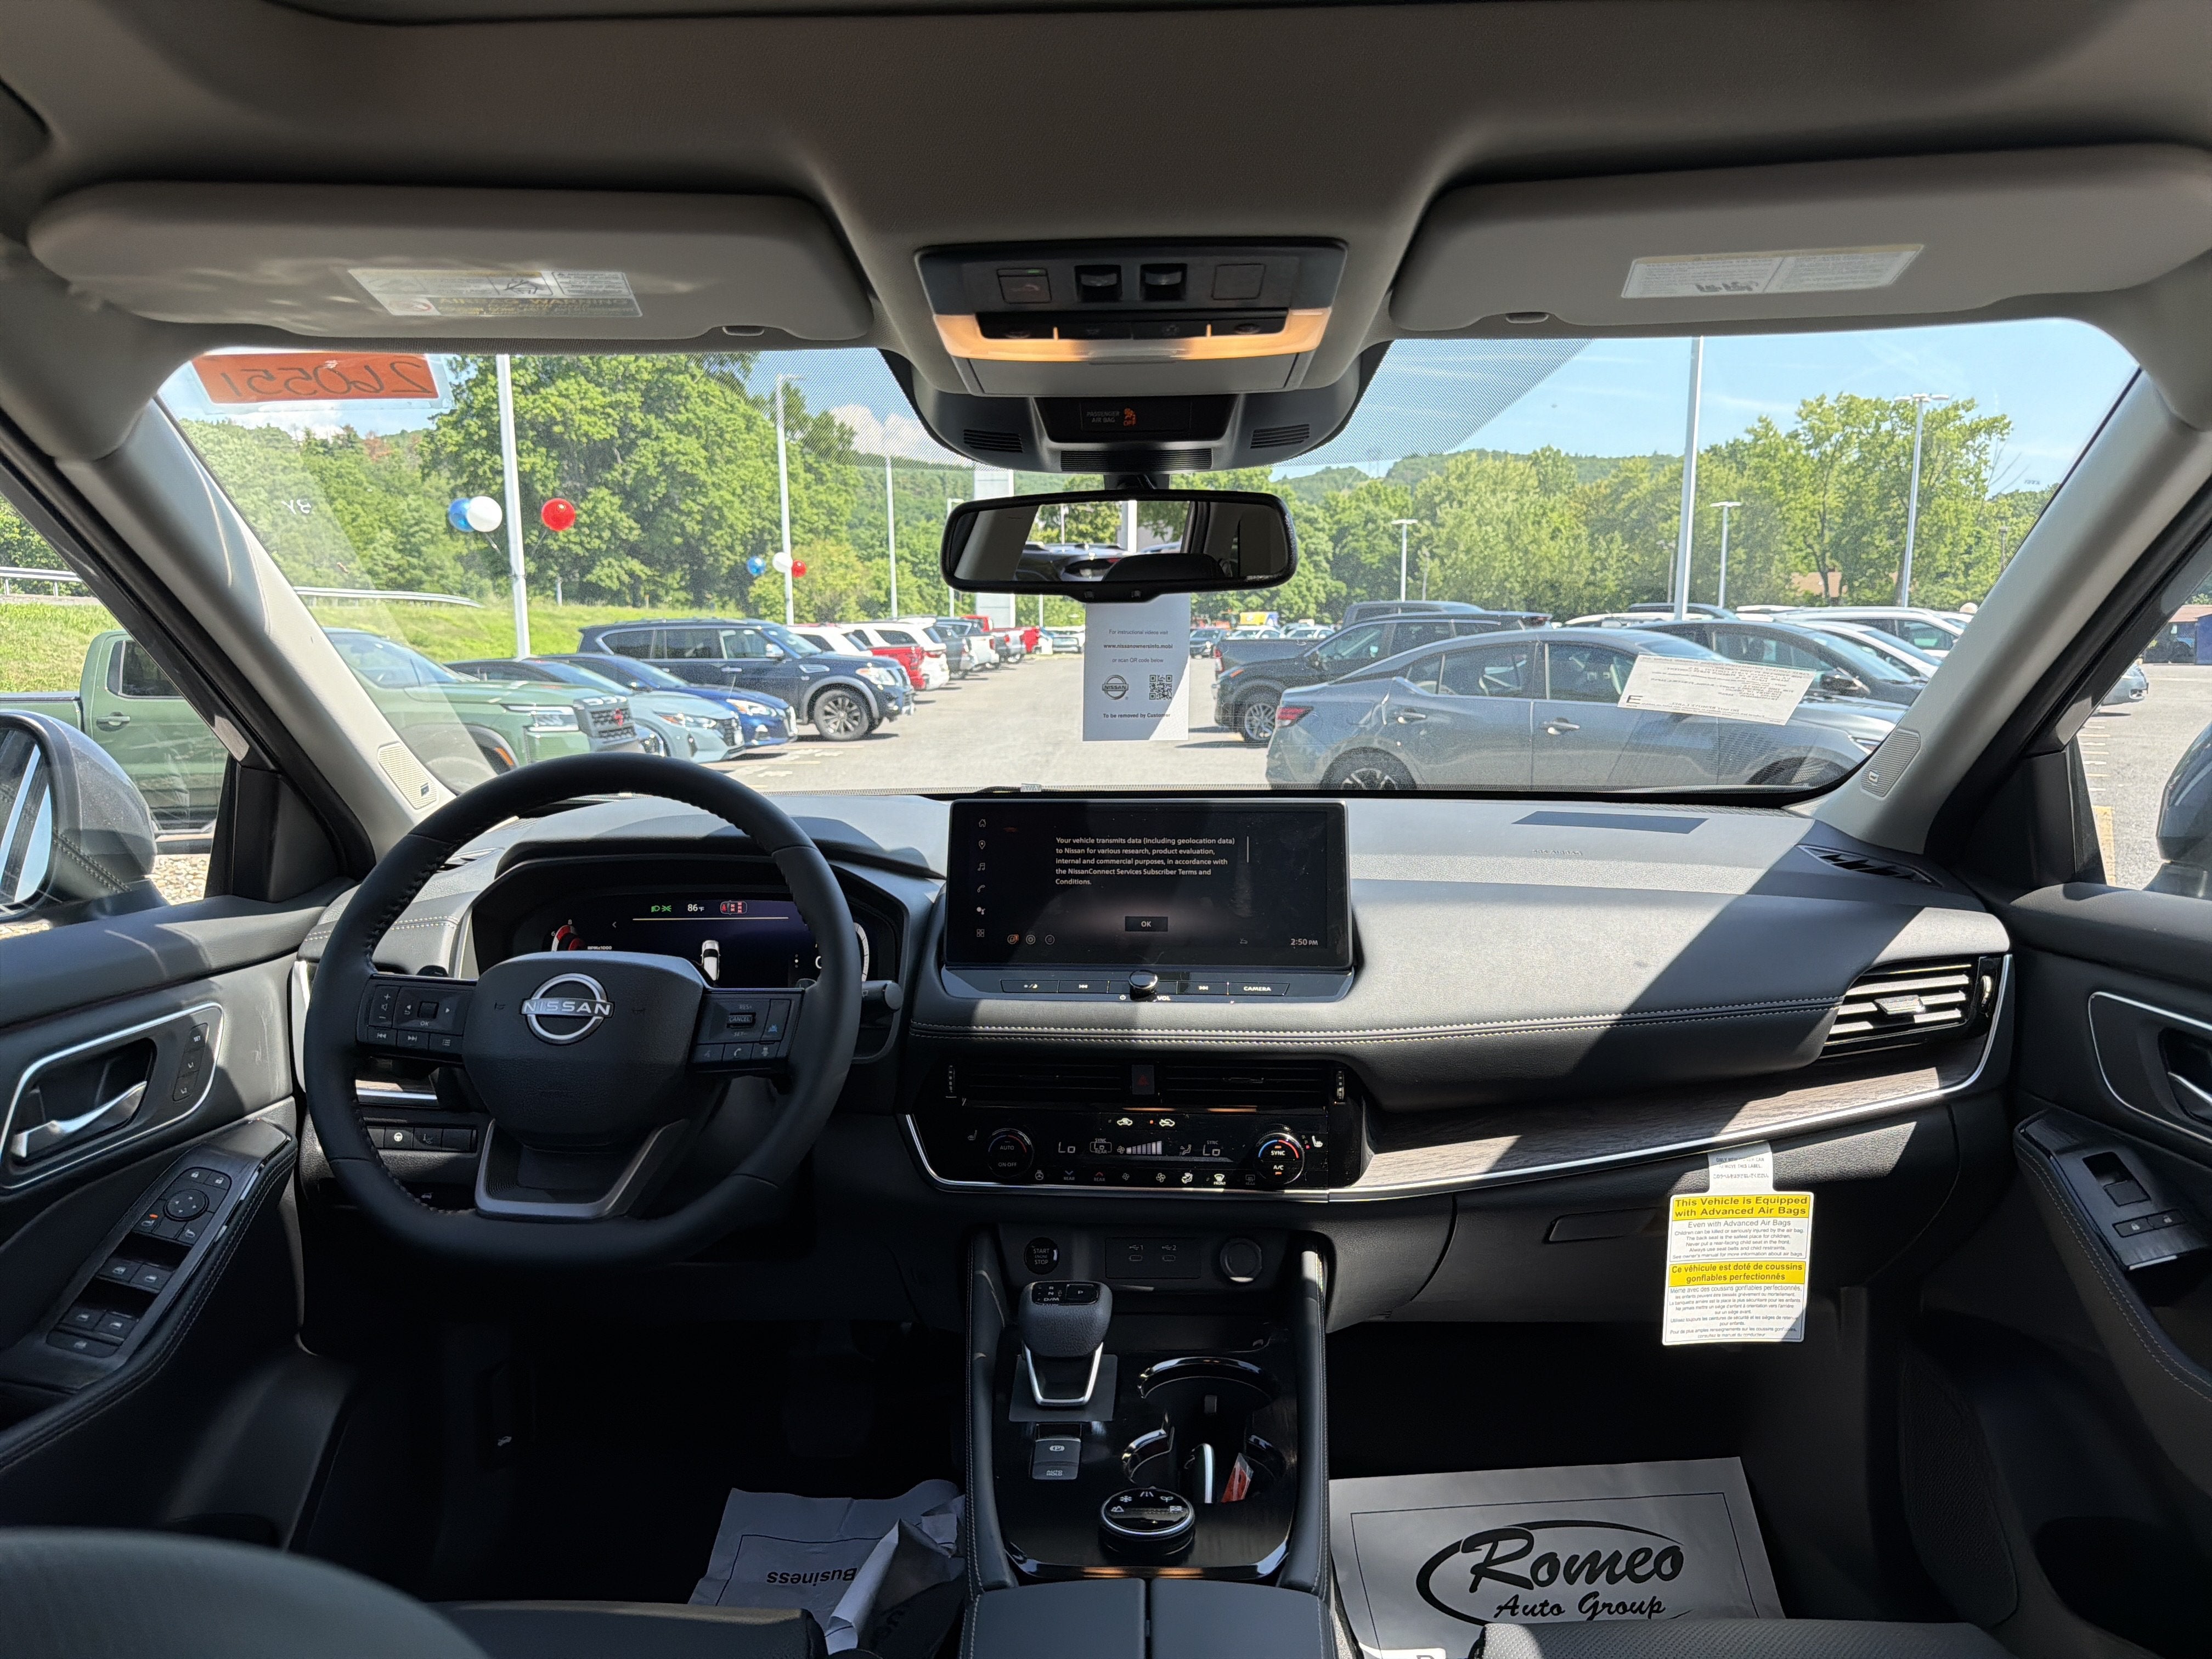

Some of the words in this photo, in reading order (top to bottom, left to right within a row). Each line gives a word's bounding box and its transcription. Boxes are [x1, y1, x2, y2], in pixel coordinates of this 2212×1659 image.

[1143, 837, 1176, 845] (including
[1177, 837, 1216, 845] geolocation
[1152, 848, 1178, 856] product
[522, 998, 611, 1016] NISSAN
[1675, 1199, 1697, 1207] This
[1701, 1197, 1739, 1205] Vehicle
[1756, 1196, 1807, 1206] Equipped
[1700, 1207, 1754, 1216] Advanced
[1778, 1207, 1806, 1216] Bags
[1684, 1264, 1717, 1272] véhicule
[1686, 1274, 1727, 1284] gonflables
[1729, 1273, 1785, 1282] perfectionnés
[1460, 1527, 1685, 1593] Romeo
[766, 1567, 858, 1587] Business
[1494, 1595, 1567, 1619] Auto
[1578, 1592, 1666, 1621] Group
